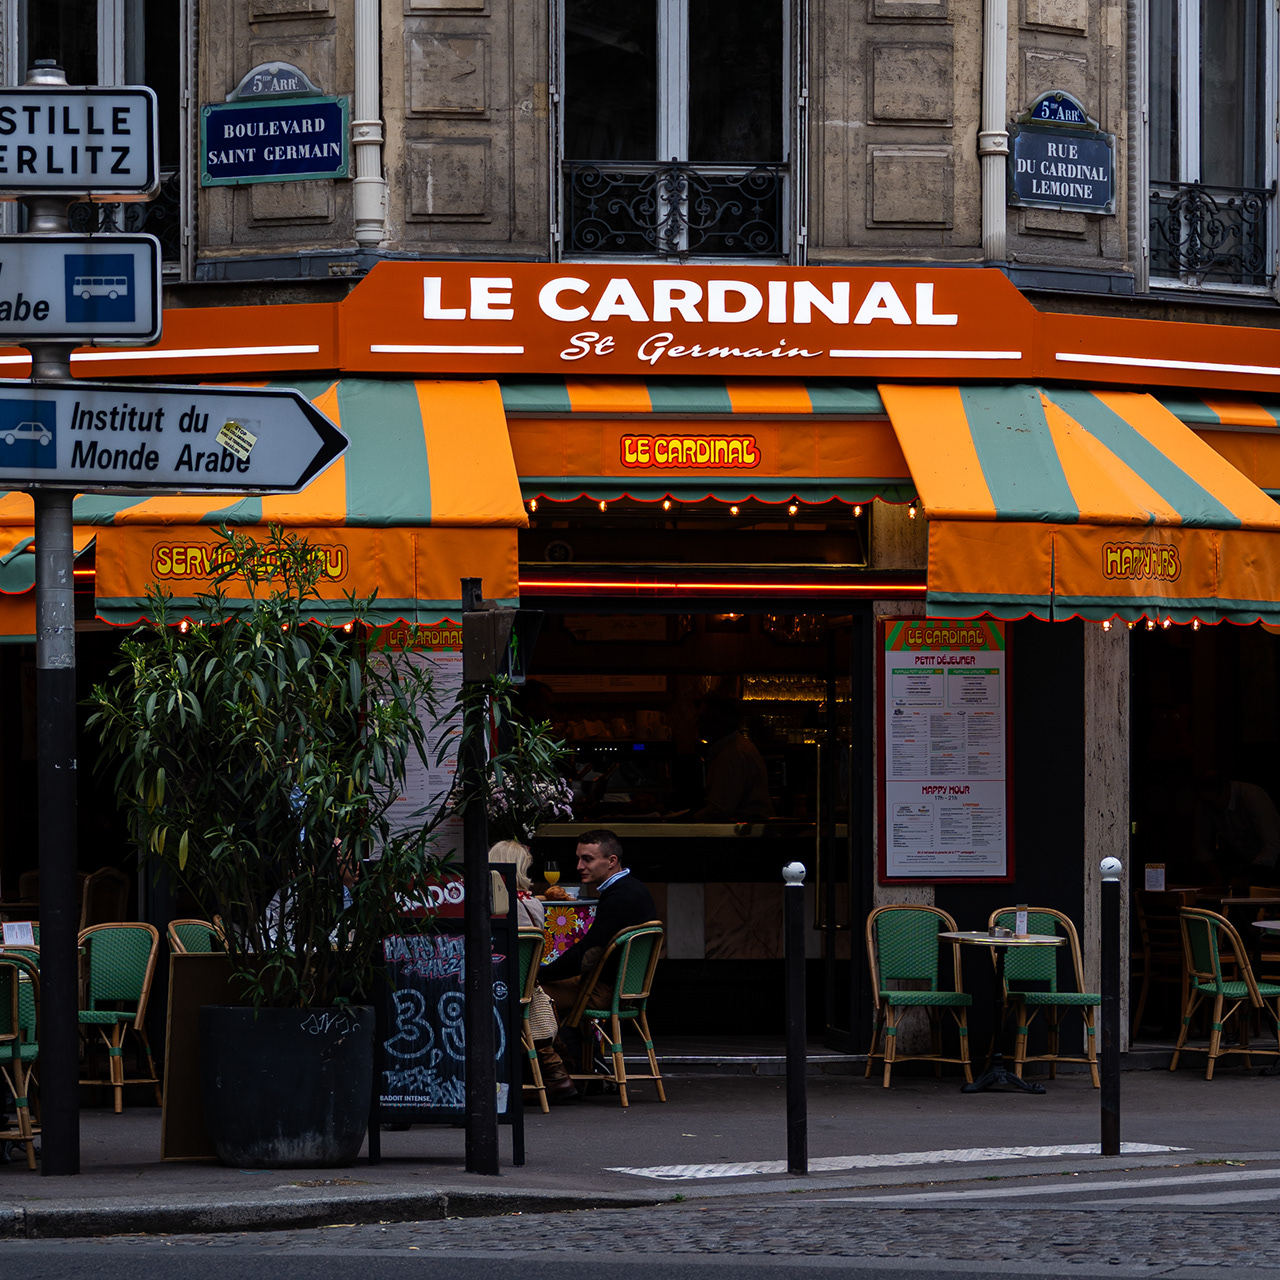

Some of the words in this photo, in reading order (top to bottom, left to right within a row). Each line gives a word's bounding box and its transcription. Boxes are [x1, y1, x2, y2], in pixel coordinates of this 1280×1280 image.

[223, 117, 326, 139] BOULEVARD
[208, 147, 256, 165] SAINT
[263, 141, 341, 161] GERMAIN
[1047, 142, 1078, 159] RUE
[1016, 158, 1037, 174] DU
[1040, 160, 1108, 182] CARDINAL
[1031, 179, 1093, 199] LEMOINE
[423, 275, 514, 321] LE
[537, 277, 959, 326] CARDINAL
[559, 331, 616, 362] St
[636, 331, 824, 366] Germain
[71, 402, 164, 433] Institut
[179, 404, 209, 434] du
[71, 440, 159, 471] Monde
[175, 441, 251, 474] Arabe
[623, 433, 658, 468] LE
[662, 433, 761, 468] CARDINAL
[389, 630, 404, 644] LE
[907, 629, 923, 645] LE
[924, 629, 984, 645] CARDINAL
[914, 655, 935, 665] PETIT
[936, 653, 976, 665] DÉJEUNER
[921, 785, 948, 795] HAPPY
[948, 785, 971, 795] HOUR
[404, 1095, 433, 1103] INTENSE,
